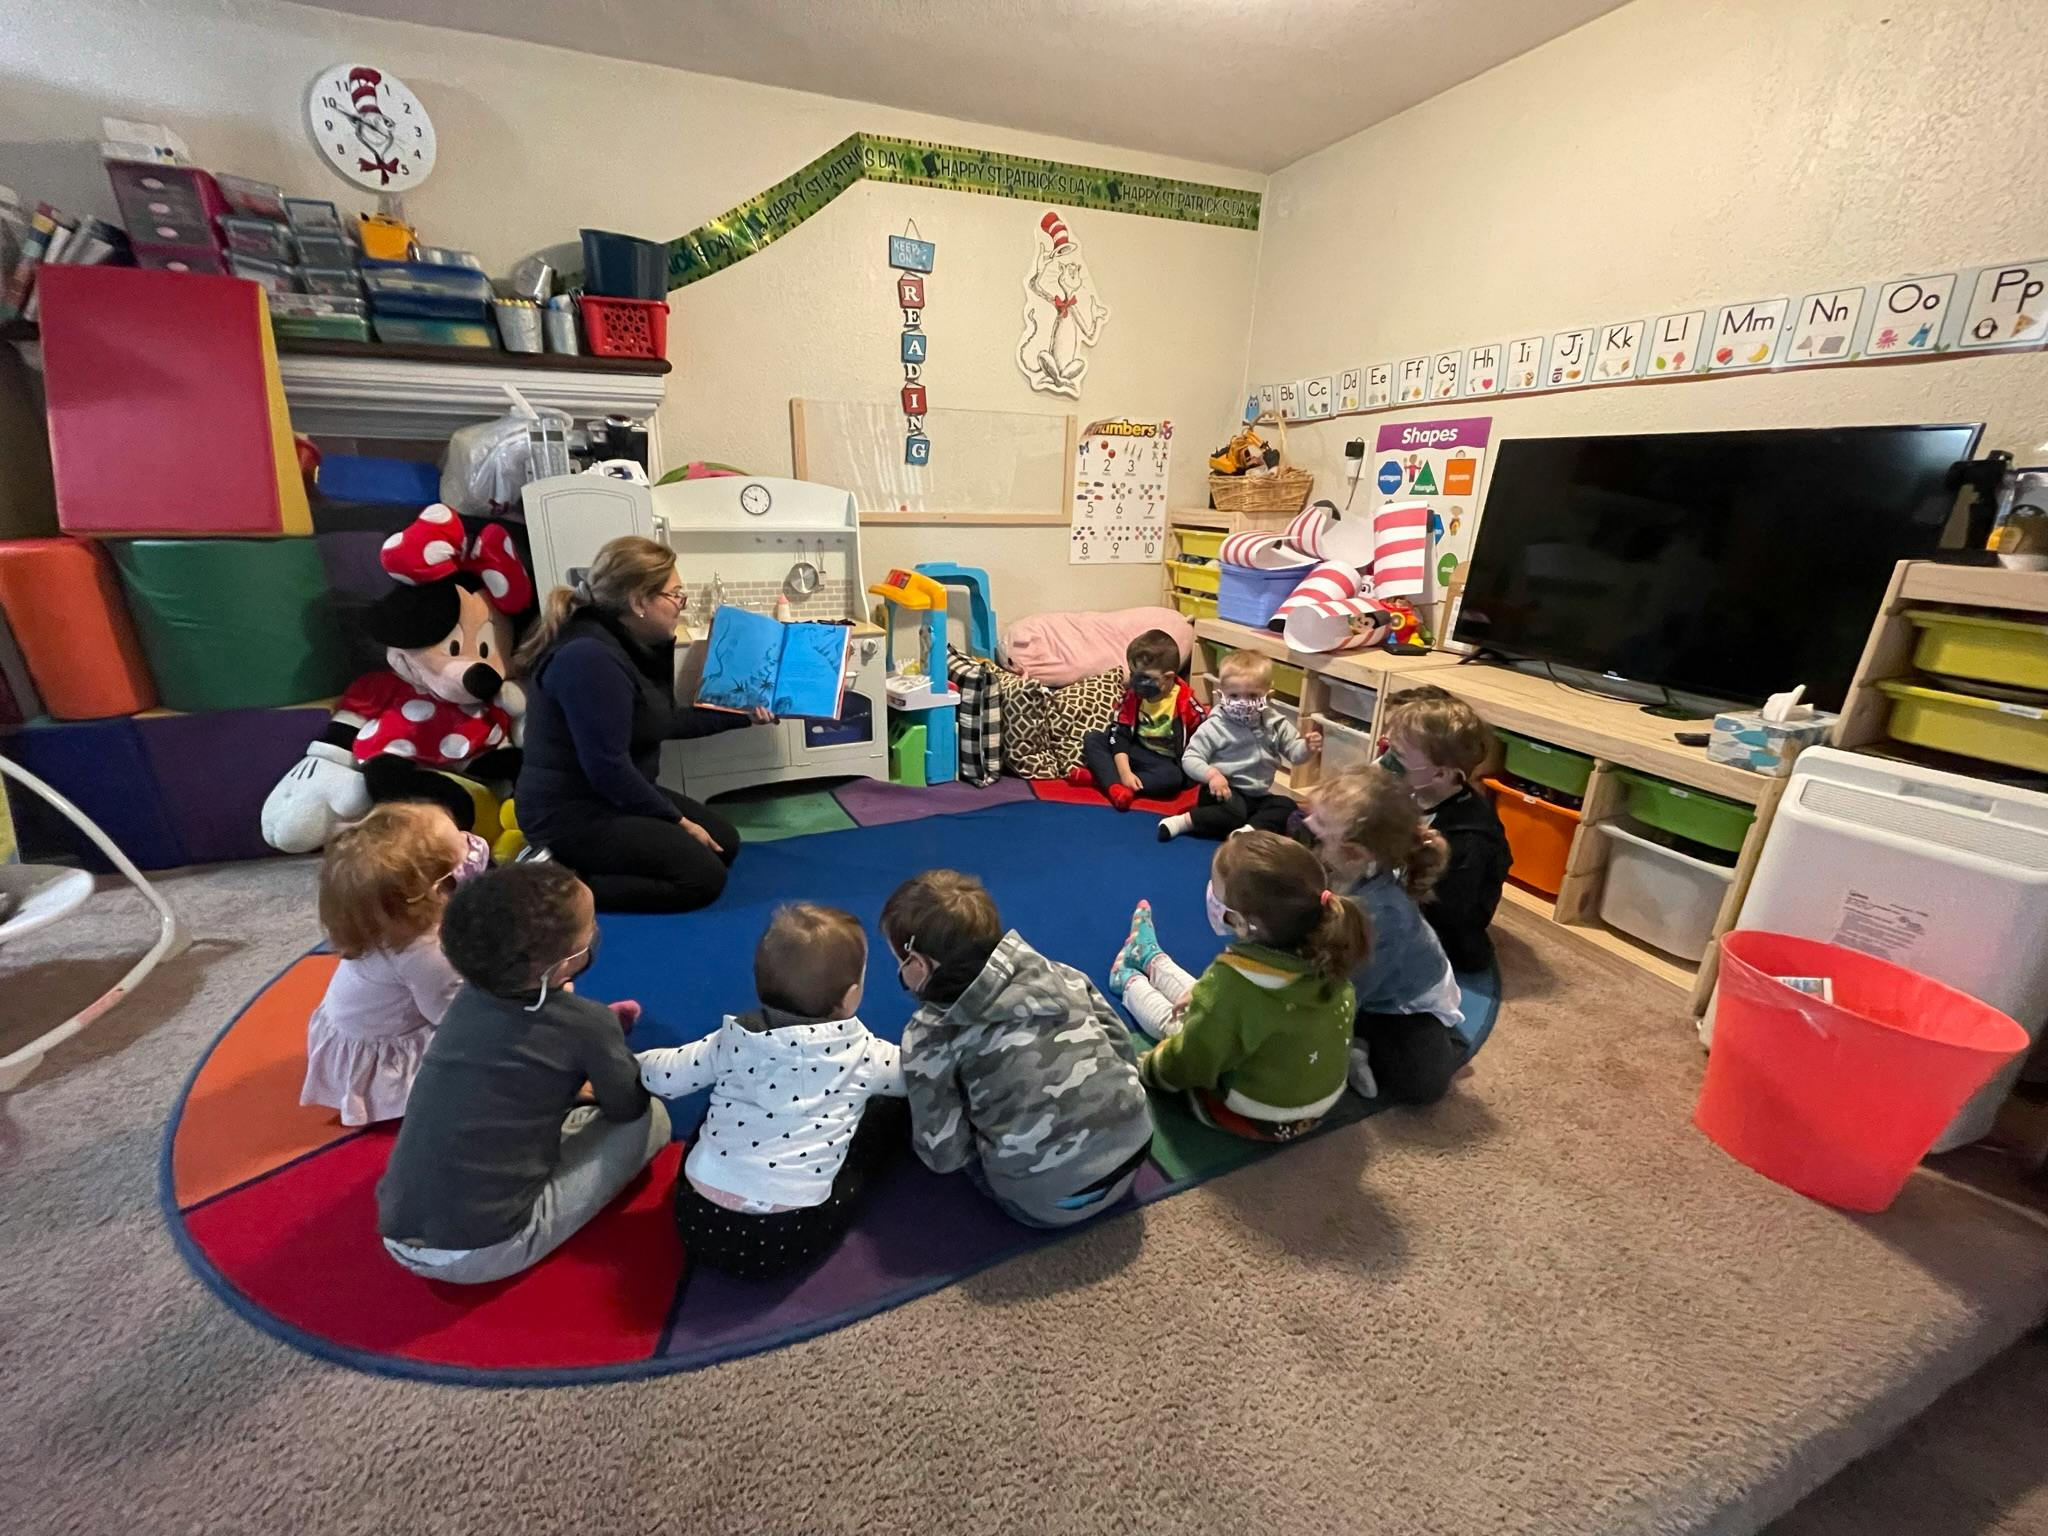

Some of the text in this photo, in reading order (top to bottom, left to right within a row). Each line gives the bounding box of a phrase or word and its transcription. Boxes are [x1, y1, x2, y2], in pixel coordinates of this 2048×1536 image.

[335, 80, 349, 92] 11
[322, 96, 337, 109] 10
[403, 103, 412, 114] 2
[325, 119, 333, 131] 9
[414, 126, 422, 138] 3
[414, 149, 421, 160] 4
[401, 164, 410, 175] 5
[941, 159, 984, 180] HAPPY
[1070, 177, 1092, 195] DAY
[762, 190, 806, 225] HAPPY
[878, 149, 905, 169] DAY
[1122, 185, 1160, 205] HAPPY
[1232, 201, 1252, 218] DAY
[893, 240, 918, 254] KEEP
[899, 252, 912, 264] ON
[1280, 386, 1294, 401] Bb
[1308, 381, 1327, 397] Cc
[1343, 374, 1357, 390] Dd
[1371, 368, 1387, 385] Ee
[1405, 360, 1424, 380] Ff
[1437, 355, 1457, 381] Gg
[1473, 348, 1494, 370] Hh
[1518, 342, 1531, 364] Ii
[1561, 334, 1584, 365] Jj
[1606, 326, 1633, 351] Kk
[1664, 317, 1689, 342] Ll
[1722, 307, 1775, 335] Mm
[1809, 296, 1848, 325] Nn
[1888, 284, 1940, 313] Oo
[1991, 268, 2045, 313] Pp
[1401, 427, 1458, 446] Shapes
[1104, 459, 1111, 472] 2
[1127, 459, 1135, 472] 3
[1155, 460, 1163, 473] 4
[1087, 501, 1155, 515] 5 6 7
[1081, 542, 1154, 555] 8 9 10
